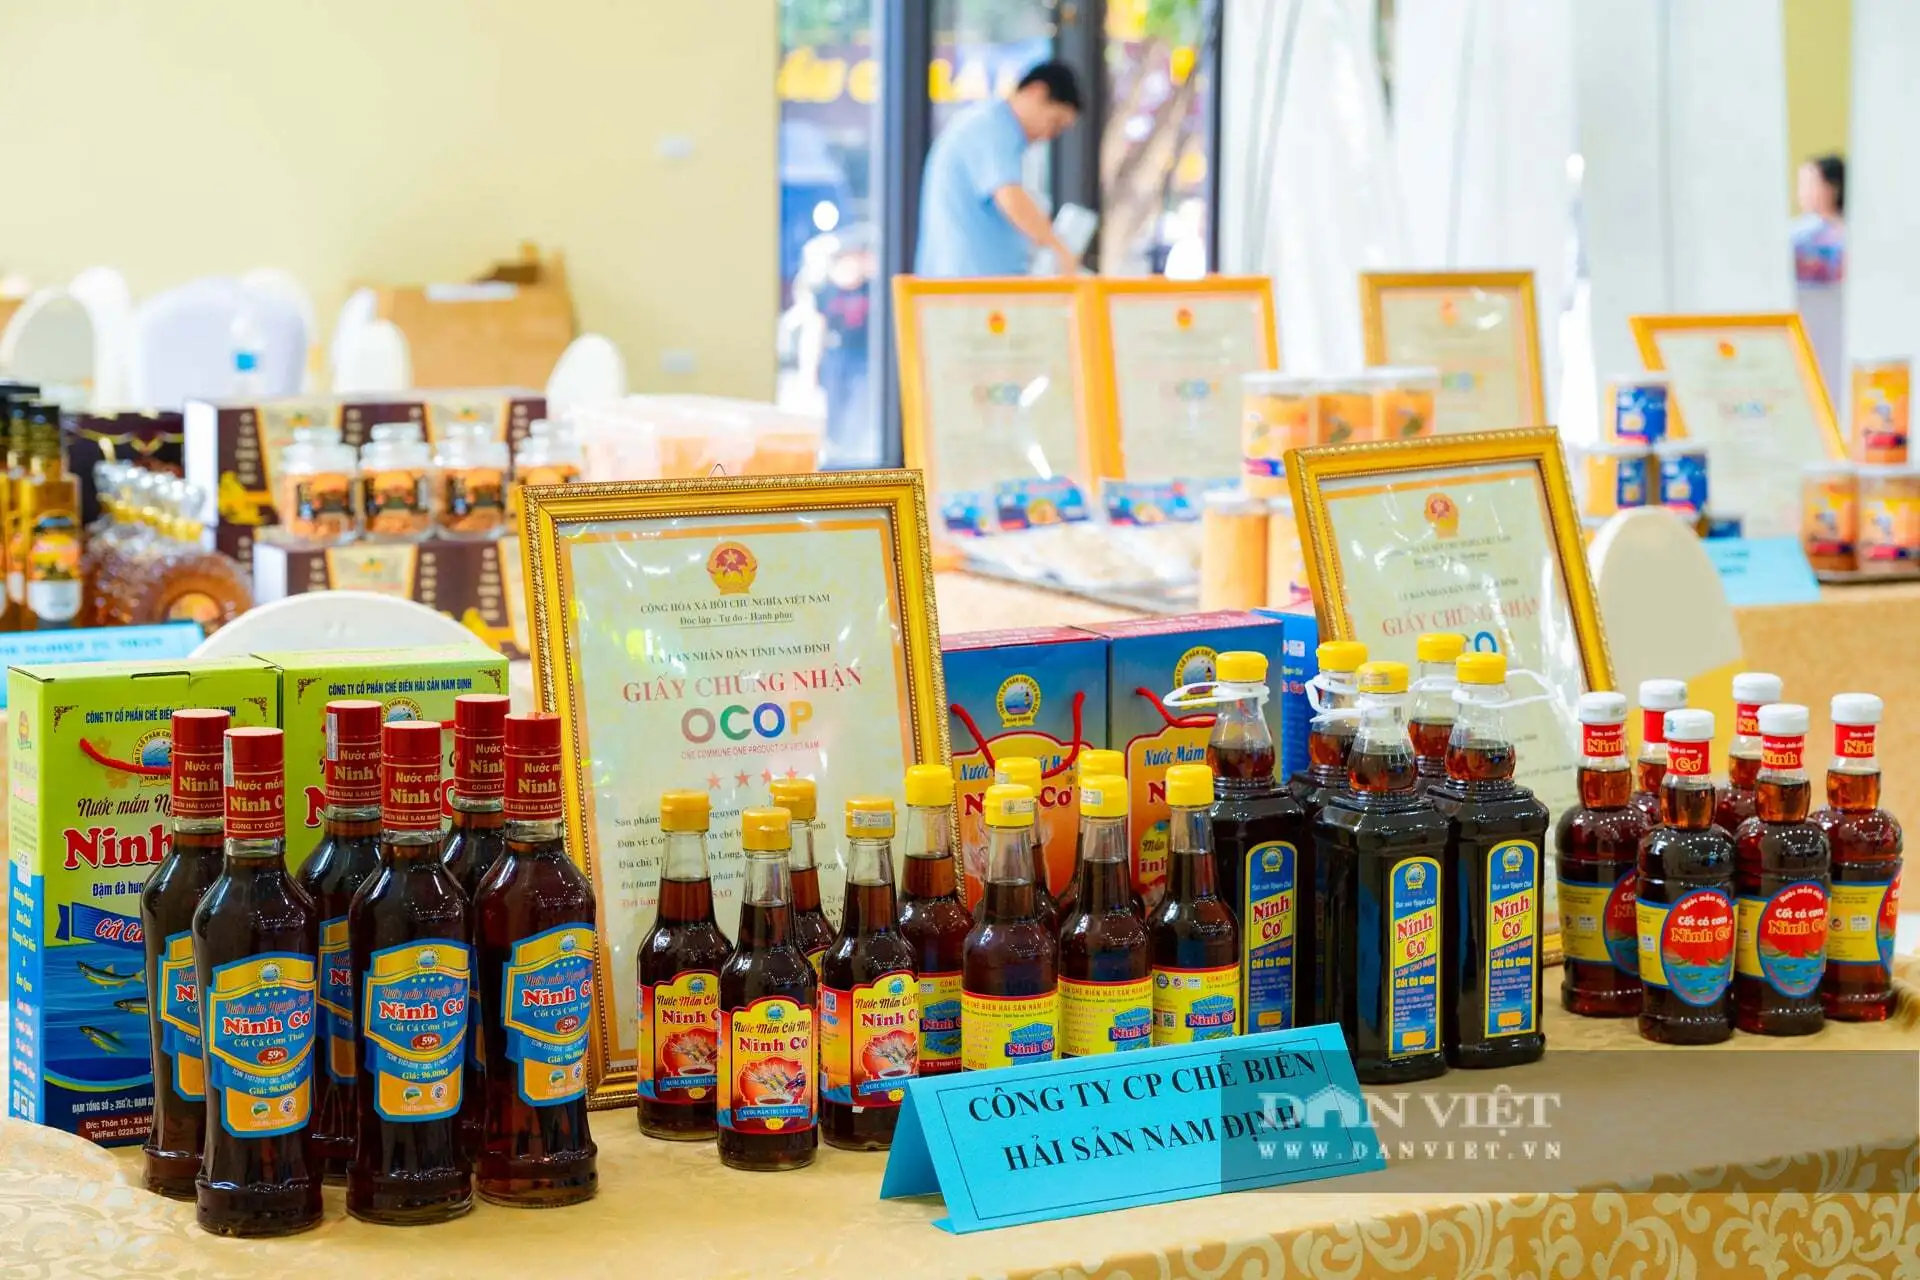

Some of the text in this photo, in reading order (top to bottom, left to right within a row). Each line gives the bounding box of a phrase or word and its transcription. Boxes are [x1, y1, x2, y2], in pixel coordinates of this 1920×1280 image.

[809, 594, 831, 604] NAM
[732, 613, 743, 622] do
[329, 683, 346, 696] CÔNG
[347, 683, 355, 695] TY
[356, 680, 365, 694] CỔ
[366, 679, 384, 694] PHẦN
[440, 678, 456, 691] NAM
[623, 662, 862, 702] GIẤY CHỨNG NHẬN
[85, 710, 104, 724] CÔNG
[106, 711, 114, 723] TY
[114, 708, 124, 723] CỔ
[125, 707, 143, 721] PHẦN
[144, 705, 158, 721] CHẾ
[681, 701, 813, 744] OCOP
[340, 749, 366, 761] Nước
[474, 743, 501, 755] Nước
[1144, 741, 1205, 767] Nước Mắm
[184, 760, 211, 772] Nước
[334, 765, 374, 781] Ninh
[525, 761, 550, 773] Nước
[959, 762, 992, 782] Nước
[179, 775, 220, 793] Ninh
[395, 771, 422, 783] Nước
[235, 780, 262, 792] Nước
[517, 778, 557, 794] Ninh
[229, 795, 271, 812] Ninh
[390, 787, 431, 804] Ninh
[1038, 785, 1074, 809] Cơ
[78, 798, 114, 817] Nước
[116, 792, 149, 816] mắm
[63, 823, 173, 871] Ninh
[92, 880, 126, 899] Đậm đà
[711, 888, 732, 899] SAO
[1252, 895, 1292, 925] Ninh
[1493, 893, 1530, 925] Ninh
[1775, 907, 1793, 919] Cốt
[95, 918, 122, 941] Cốt
[1396, 911, 1434, 943] Ninh
[1677, 915, 1696, 927] Cốt
[1697, 915, 1710, 927] cá
[1767, 919, 1810, 936] Ninh
[1262, 919, 1284, 942] Cơ
[1502, 919, 1522, 941] Cơ
[1670, 926, 1714, 943] Ninh
[1406, 936, 1426, 961] Cơ
[521, 985, 577, 1008] Ninh
[656, 994, 677, 1007] Nước
[679, 994, 702, 1007] Mắm
[855, 996, 901, 1009] Nước Mắm
[378, 995, 465, 1022] Ninh Cơ
[534, 1008, 549, 1018] Cốt
[551, 1007, 562, 1017] Cá
[661, 1009, 706, 1025] Ninh
[222, 1006, 312, 1036] Ninh Cơ
[862, 1012, 905, 1027] Ninh
[922, 1018, 954, 1031] Ninh
[1189, 1010, 1235, 1026] Ninh Cơ
[389, 1022, 404, 1033] Cốt
[406, 1022, 419, 1033] Cá
[734, 1021, 754, 1033] Nước
[756, 1021, 780, 1035] Mắm
[1112, 1026, 1142, 1041] Ninh
[234, 1038, 249, 1048] Cốt
[251, 1039, 265, 1048] Cá
[738, 1036, 809, 1053] Ninh Cơ
[1008, 1038, 1056, 1056] Ninh Cơ
[968, 1047, 1318, 1123] CÔNG TY CP CHẾ BIẾN
[1001, 1105, 1301, 1172] HẢI SẢN NAM ĐỊNH
